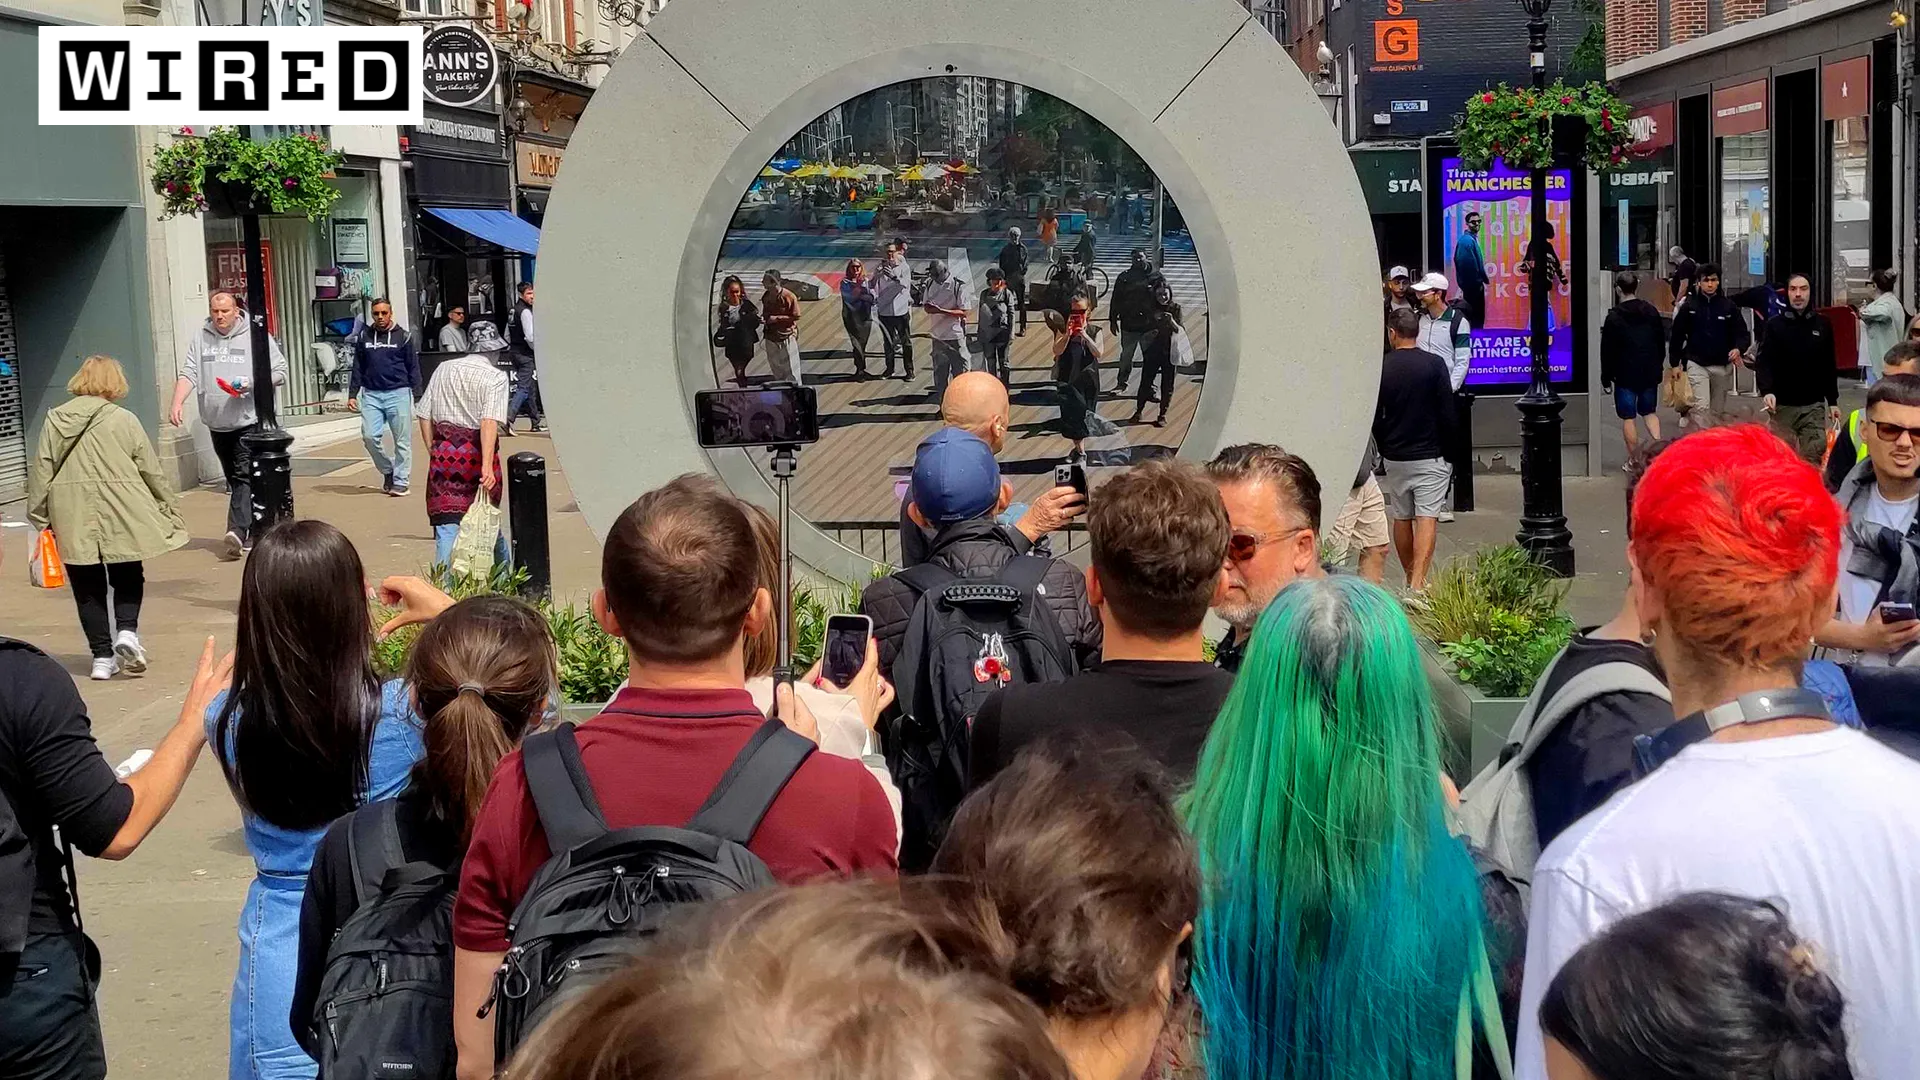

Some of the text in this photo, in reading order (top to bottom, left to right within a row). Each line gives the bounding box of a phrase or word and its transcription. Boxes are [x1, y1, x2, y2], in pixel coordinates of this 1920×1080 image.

[1382, 26, 1411, 56] G
[423, 51, 489, 70] ANN'S
[435, 72, 476, 81] BAKERY
[1388, 179, 1422, 193] STA
[1446, 176, 1566, 192] MANCHESER
[1494, 337, 1521, 348] ARE
[1512, 347, 1532, 358] FO
